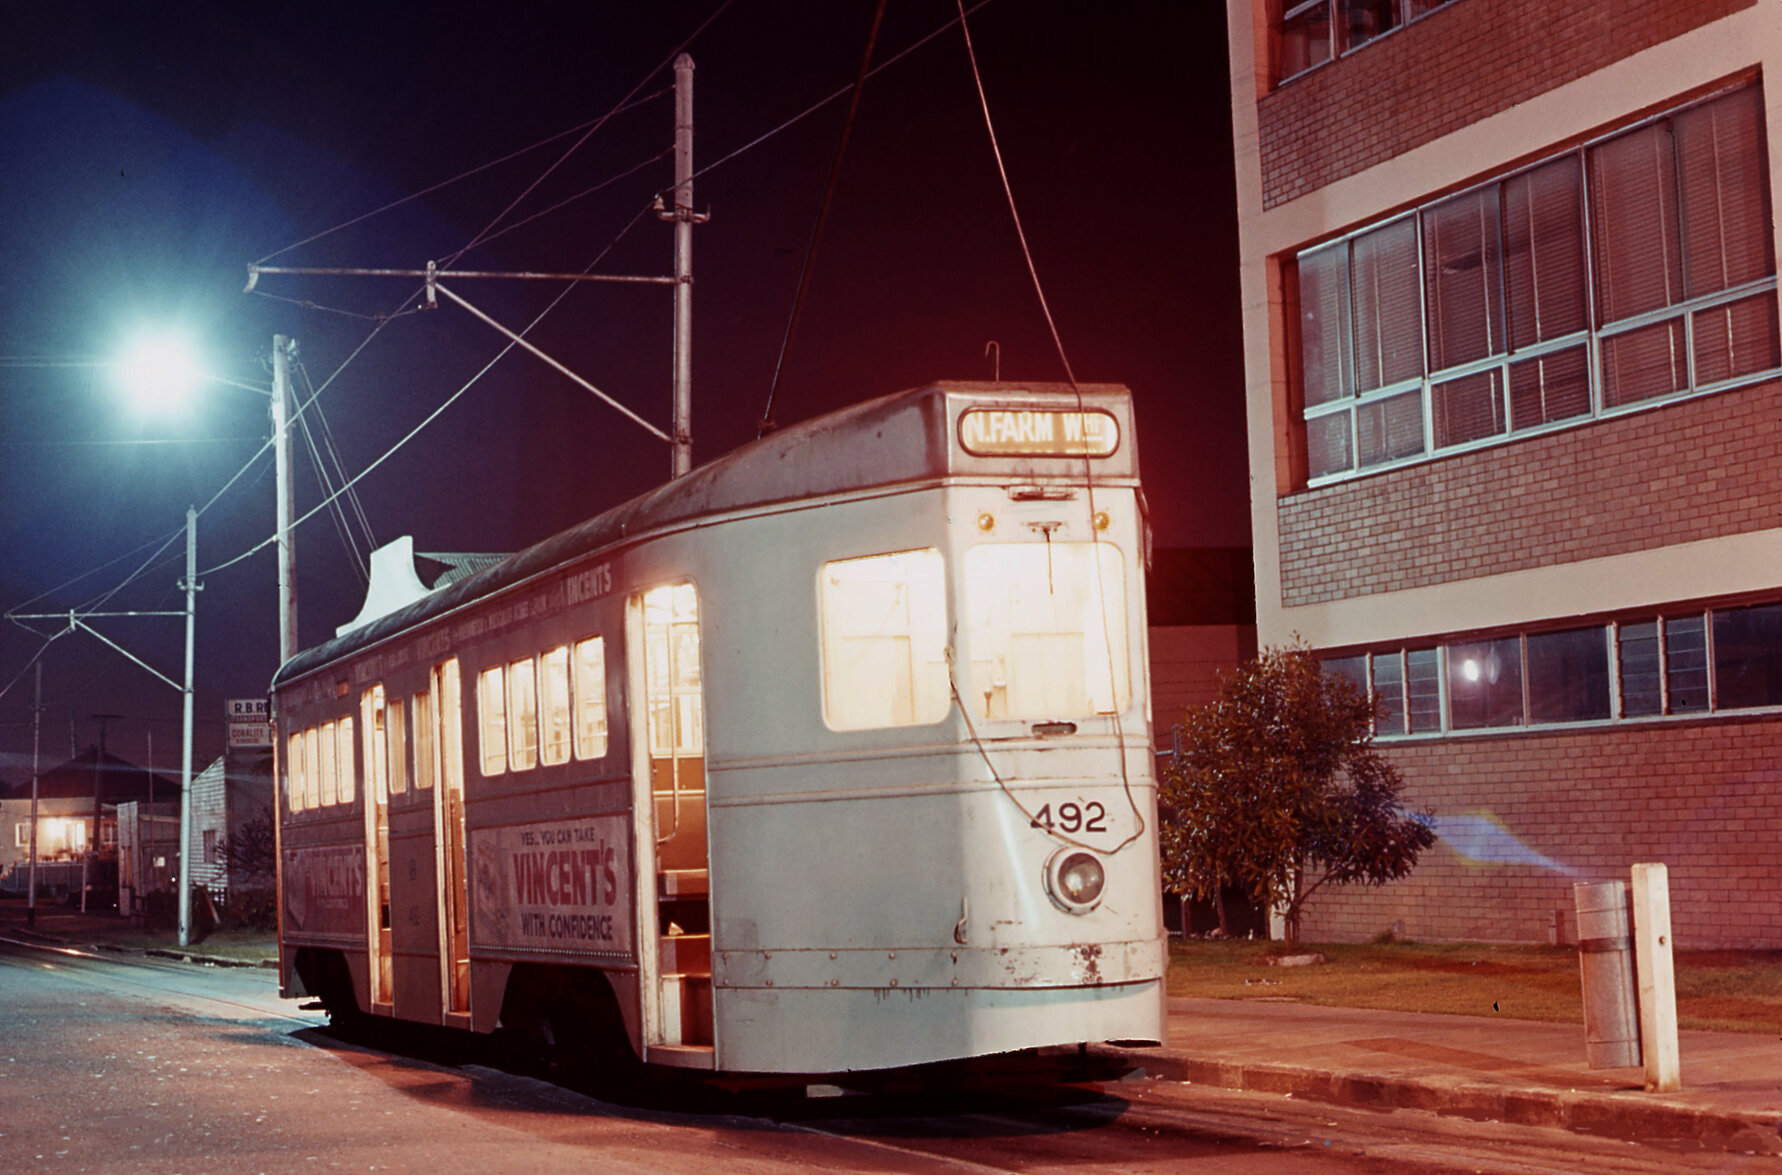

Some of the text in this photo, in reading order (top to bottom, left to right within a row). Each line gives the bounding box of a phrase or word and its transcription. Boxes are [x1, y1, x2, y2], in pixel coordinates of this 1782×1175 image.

[1030, 801, 1107, 833] 492
[540, 830, 555, 845] YOU
[557, 829, 572, 844] CAN
[574, 827, 595, 842] TAKE
[512, 838, 618, 907] VINCENT'S
[521, 913, 614, 941] WITH CONFIDENCE
